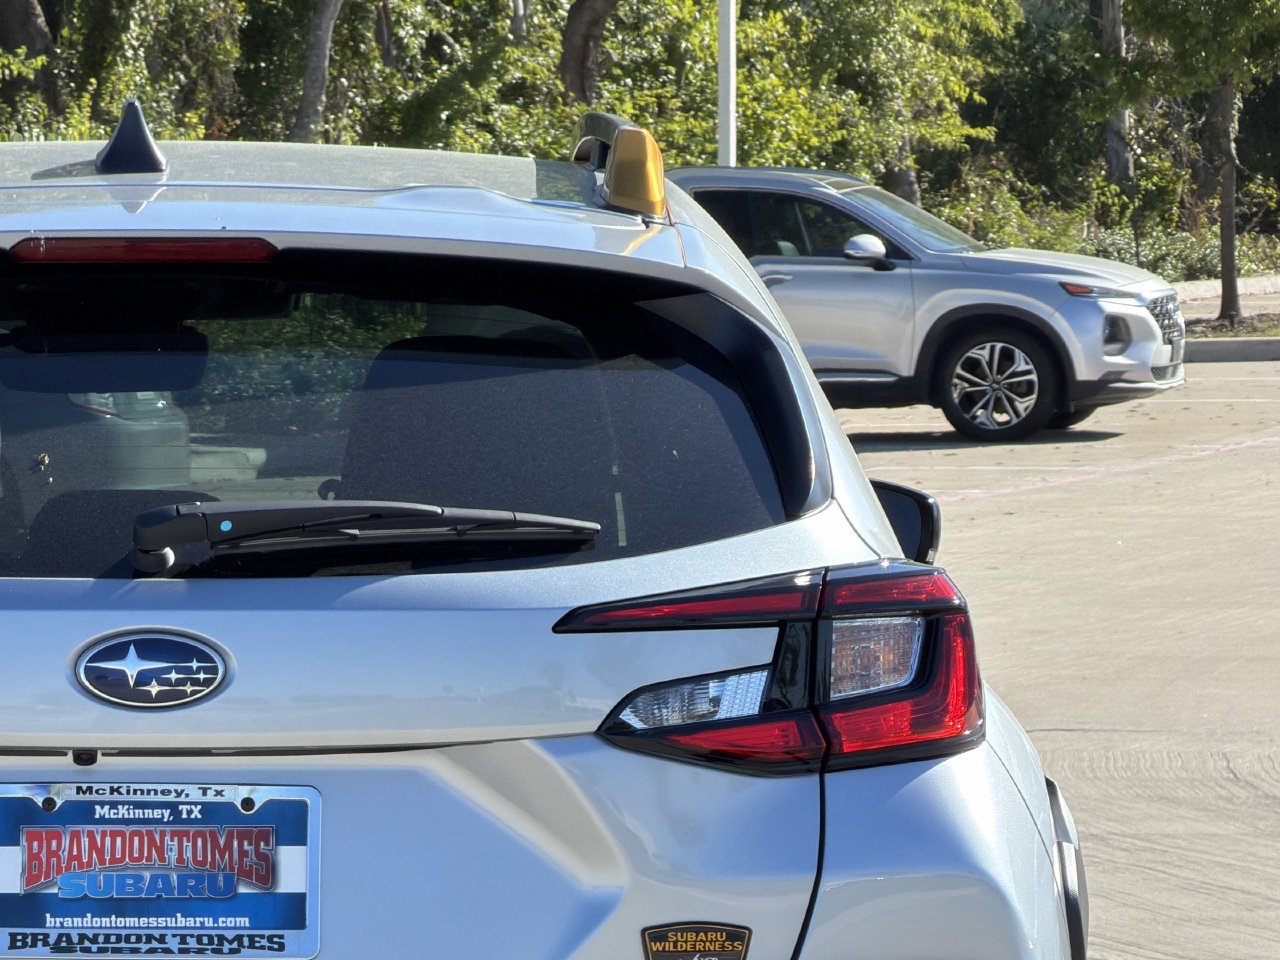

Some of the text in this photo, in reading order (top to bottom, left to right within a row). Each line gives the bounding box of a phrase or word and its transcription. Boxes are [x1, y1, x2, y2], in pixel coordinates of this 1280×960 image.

[75, 785, 225, 799] McKinney, Tx
[94, 804, 202, 822] McKinney, TX
[58, 872, 237, 898] SUBARU
[45, 913, 250, 928] brandontomessubaru.com
[7, 932, 286, 952] BRANDON TOMES
[667, 931, 727, 942] SUBARU
[49, 945, 242, 955] SUBARU
[650, 941, 743, 952] WILDERNESS
